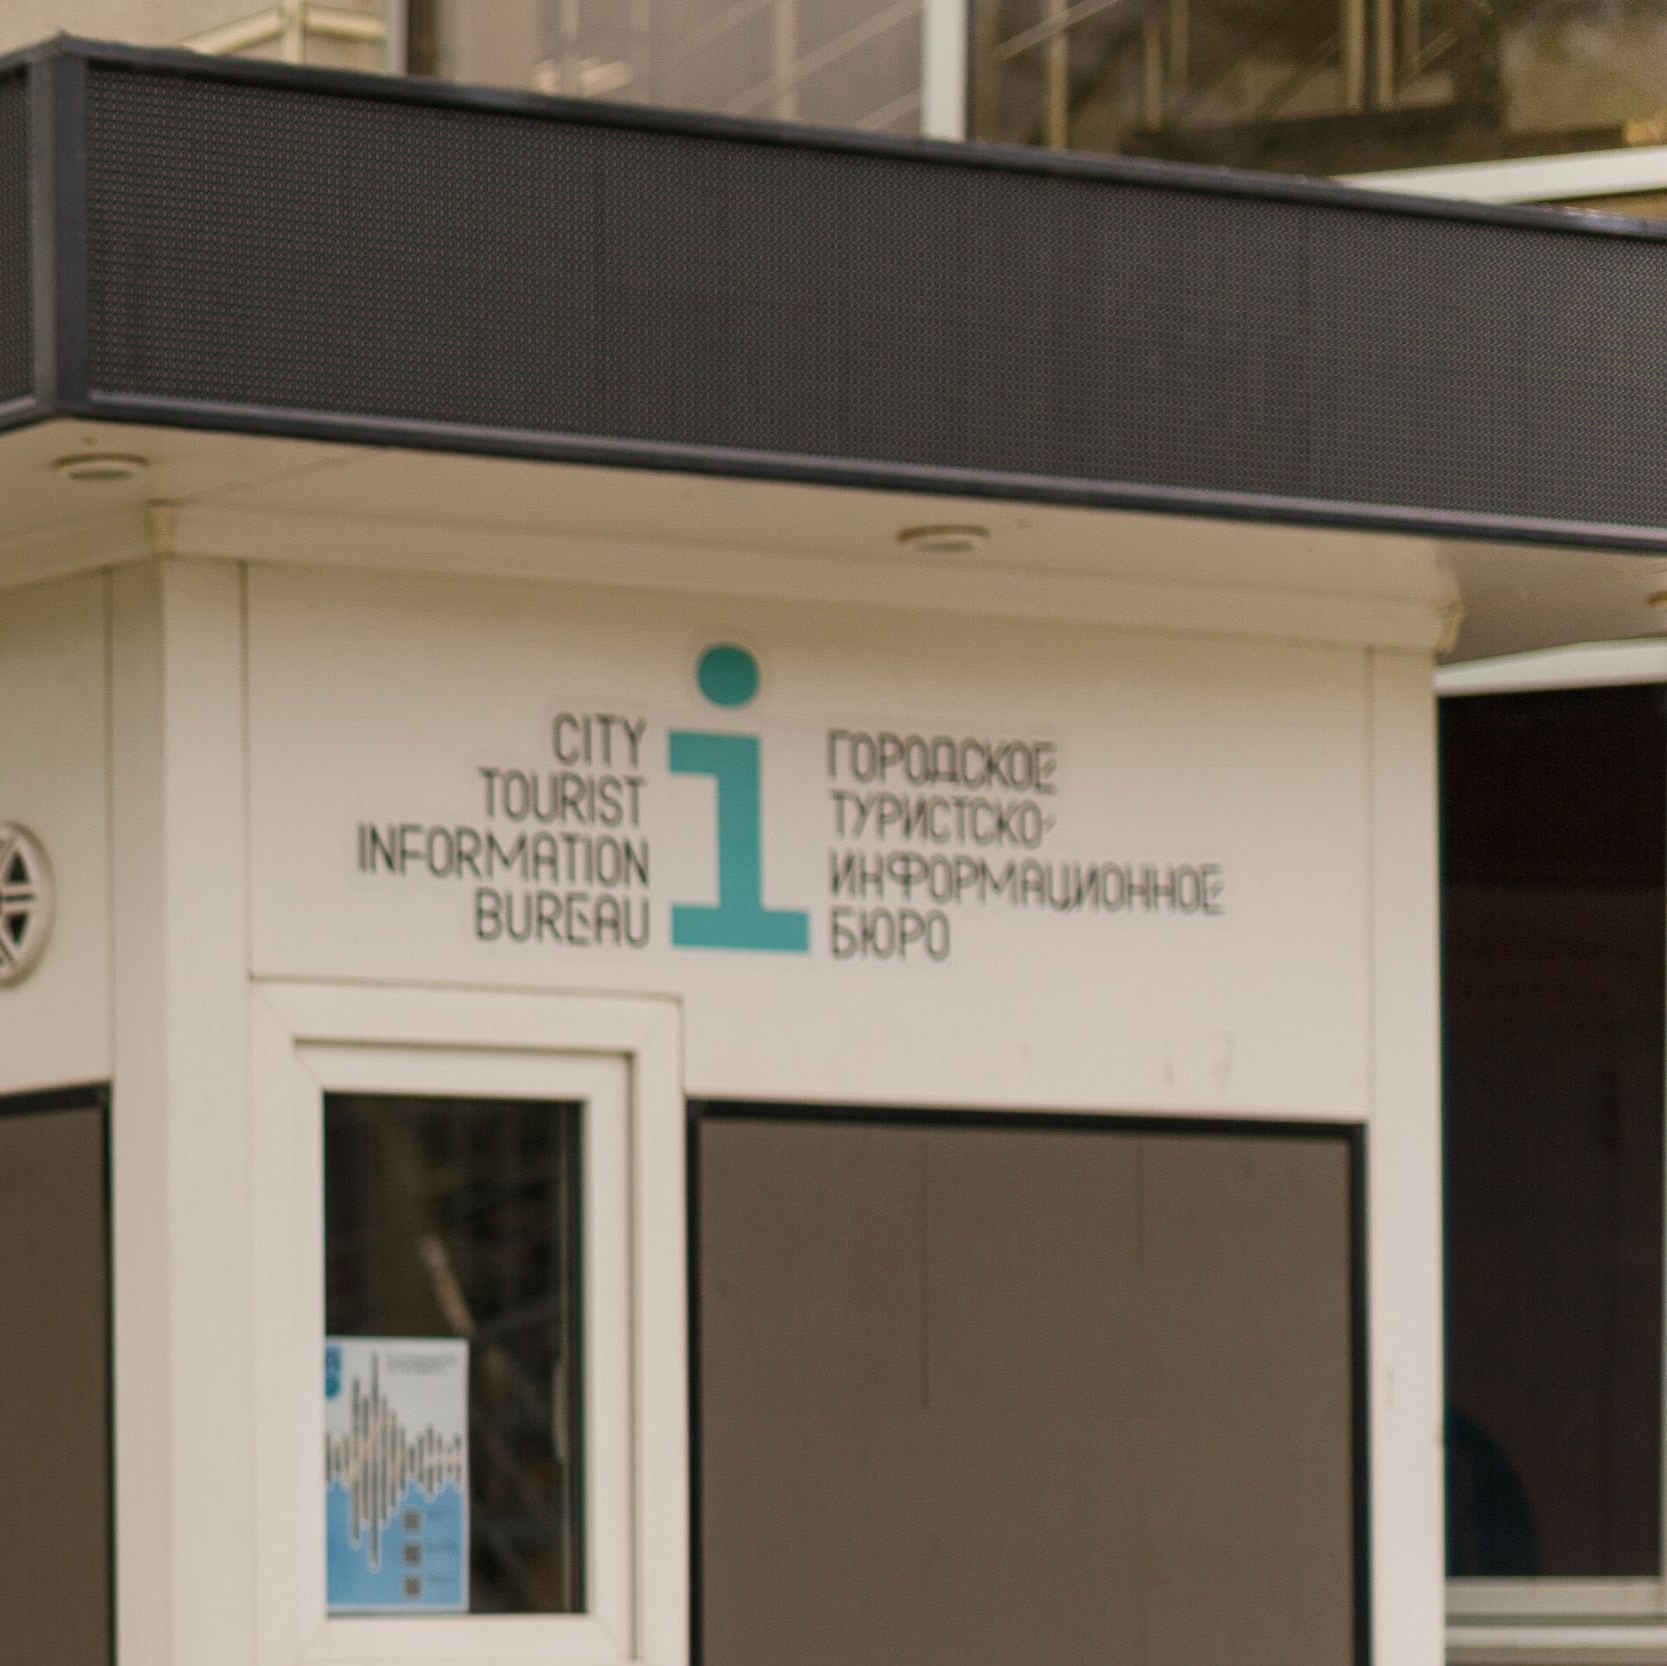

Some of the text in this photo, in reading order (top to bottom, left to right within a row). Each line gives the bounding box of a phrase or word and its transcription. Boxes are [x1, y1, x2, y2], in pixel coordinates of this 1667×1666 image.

[552, 712, 647, 768] CITY
[827, 728, 1057, 795] ГОРОДСКОЕ
[478, 767, 648, 828] TOURIST
[358, 821, 651, 888] INFORMATION
[827, 847, 1226, 917] ИНФОРМАЦИОННОЕ
[474, 888, 651, 949] BUREAU
[828, 904, 950, 963] БЮРО
